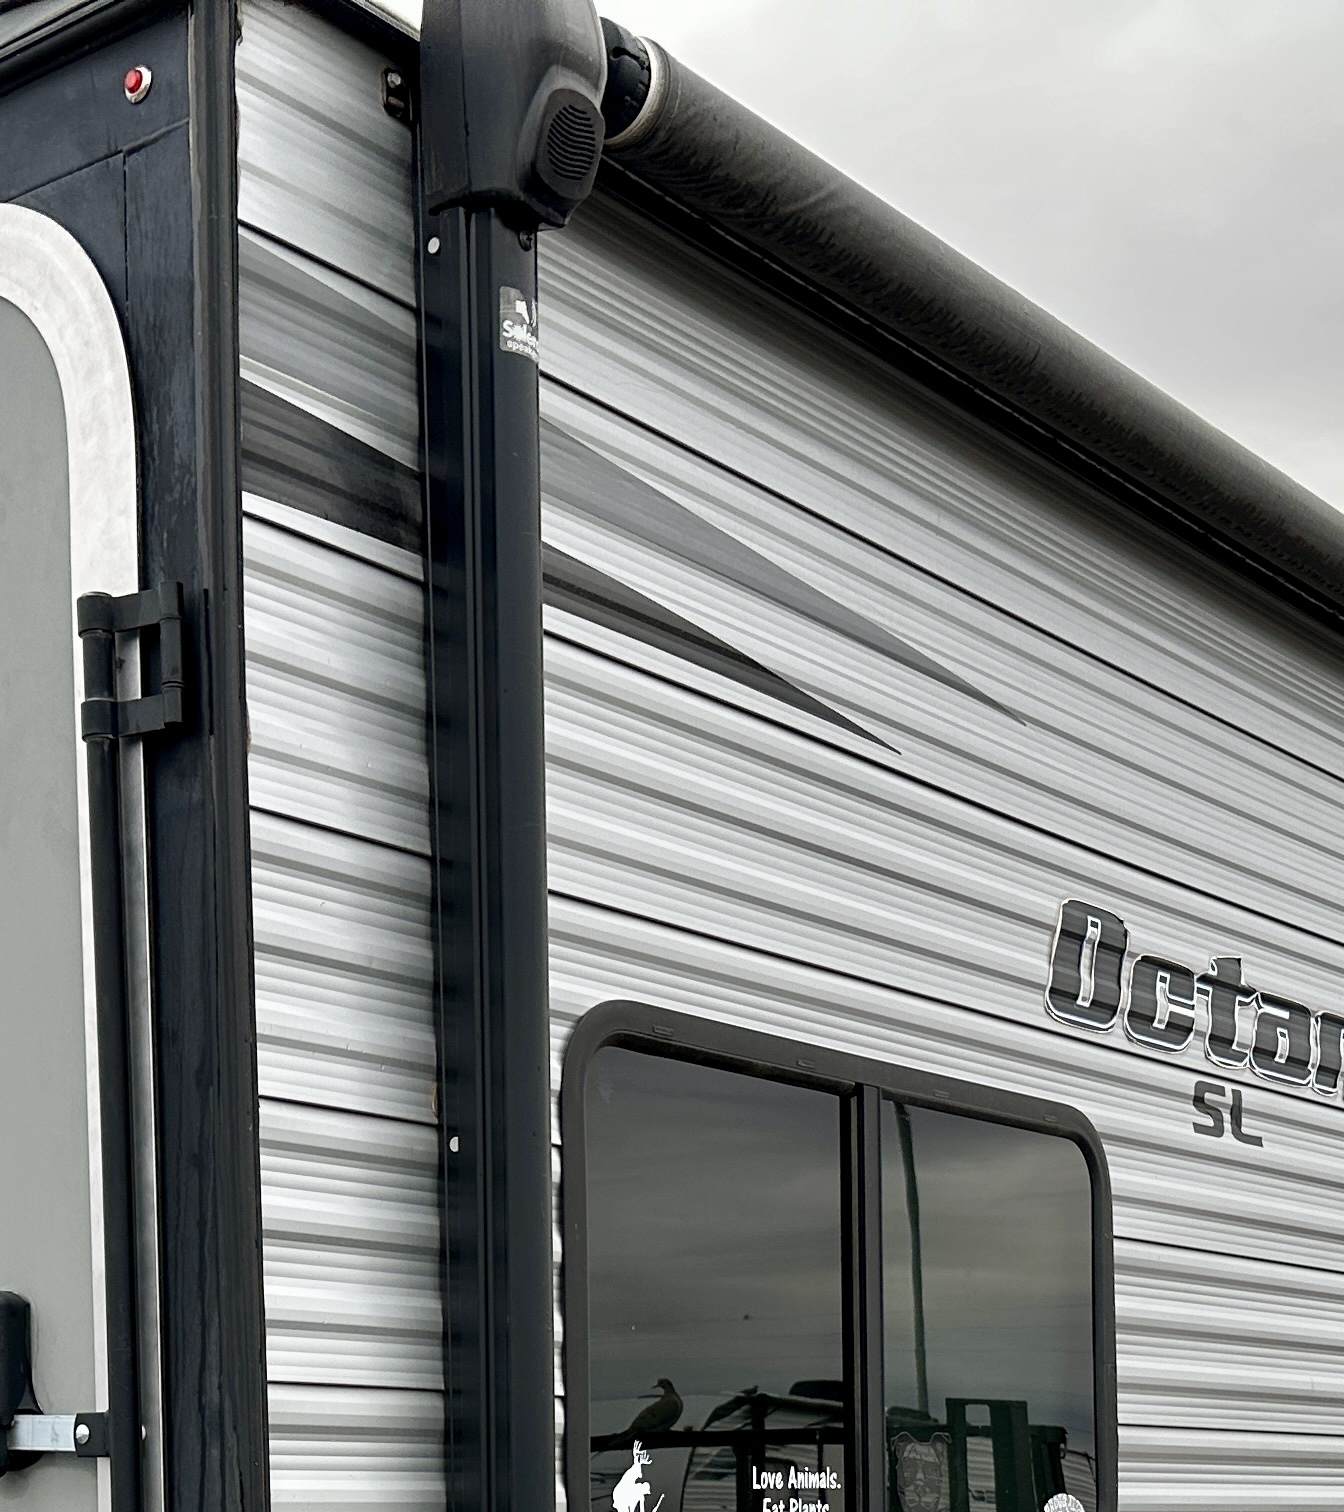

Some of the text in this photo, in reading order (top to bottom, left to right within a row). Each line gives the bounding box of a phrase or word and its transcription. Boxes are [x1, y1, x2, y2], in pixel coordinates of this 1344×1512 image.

[1192, 1079, 1264, 1148] SL
[752, 1465, 842, 1490] Love Animals.
